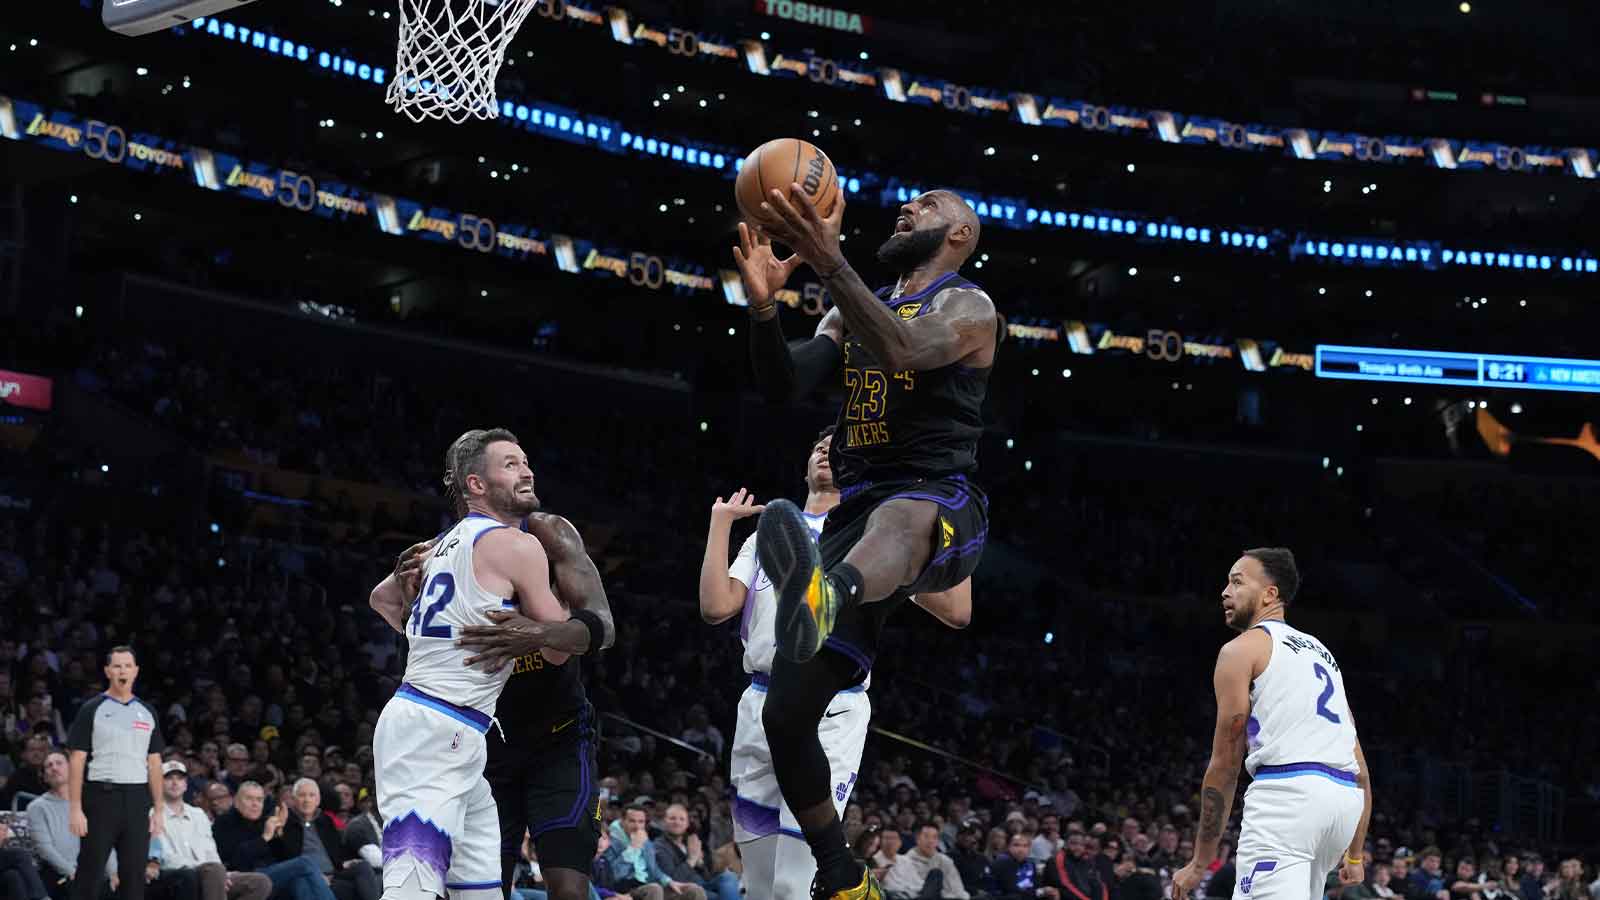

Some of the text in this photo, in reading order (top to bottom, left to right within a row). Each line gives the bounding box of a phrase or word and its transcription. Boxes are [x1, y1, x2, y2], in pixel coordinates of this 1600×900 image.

[765, 0, 864, 34] TOSHIBA
[192, 16, 386, 84] PARTNERS SINCE
[83, 120, 127, 163] 50
[128, 142, 184, 169] TOYOTA
[496, 101, 611, 141] EGENDARY
[620, 131, 725, 169] PARTNERS
[277, 169, 316, 212] 50
[316, 190, 368, 216] TOYOTA
[458, 213, 496, 253] 50
[496, 231, 547, 255] TOYOTA
[1026, 208, 1137, 235] PARTNERS
[1146, 221, 1211, 243] SINCE
[629, 251, 664, 290] 50
[1306, 241, 1598, 272] LEGENDARY PARTNERS SIN
[1146, 328, 1182, 362] 50
[845, 368, 888, 421] 23
[847, 421, 889, 448] AKERS
[411, 572, 456, 638] 42
[513, 650, 544, 674] ERS
[1313, 662, 1341, 724] 2
